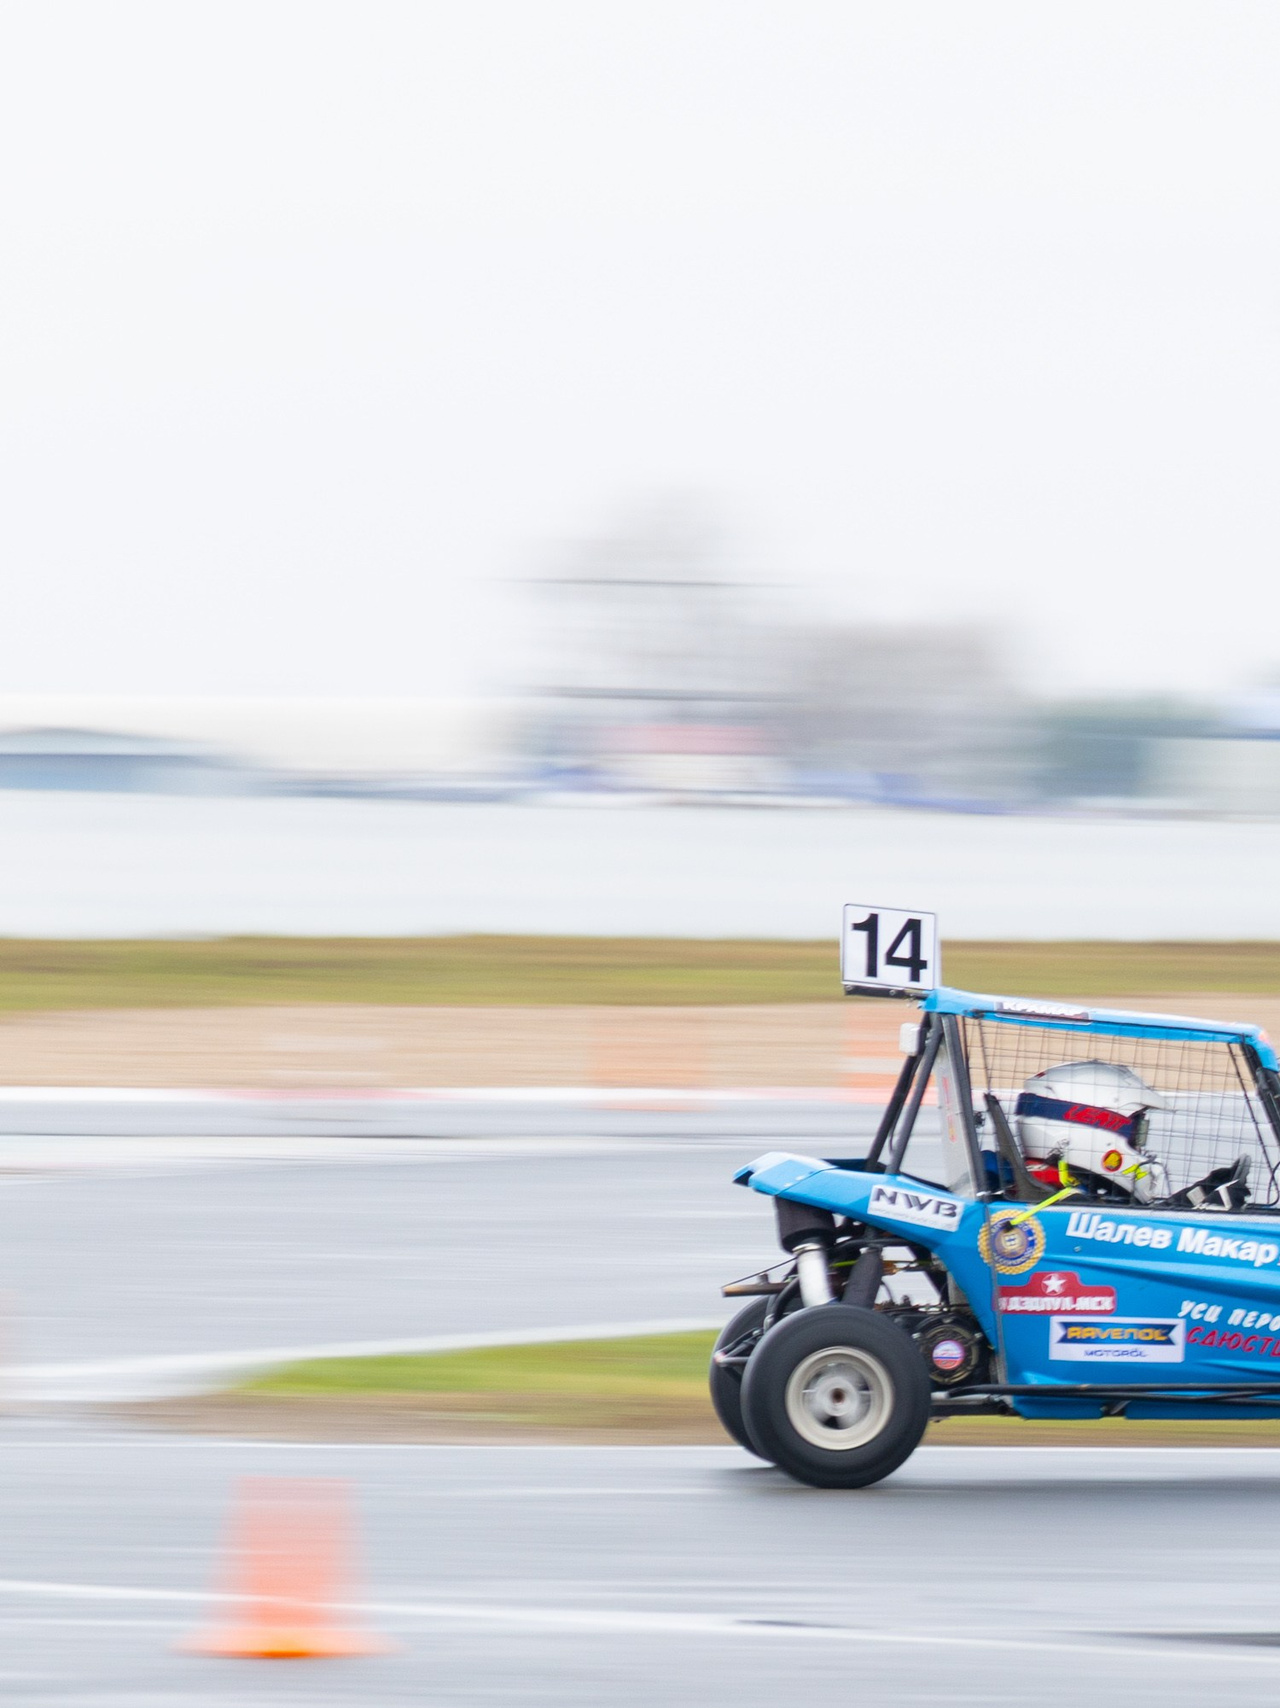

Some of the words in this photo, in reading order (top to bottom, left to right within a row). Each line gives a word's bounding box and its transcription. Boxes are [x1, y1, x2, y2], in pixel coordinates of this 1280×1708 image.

[851, 912, 928, 983] 14
[872, 1187, 958, 1218] NWB
[1065, 1211, 1173, 1249] Шалев
[1177, 1226, 1279, 1267] Макар
[1177, 1299, 1223, 1323] УСЦ
[1067, 1326, 1168, 1341] RAVENOL
